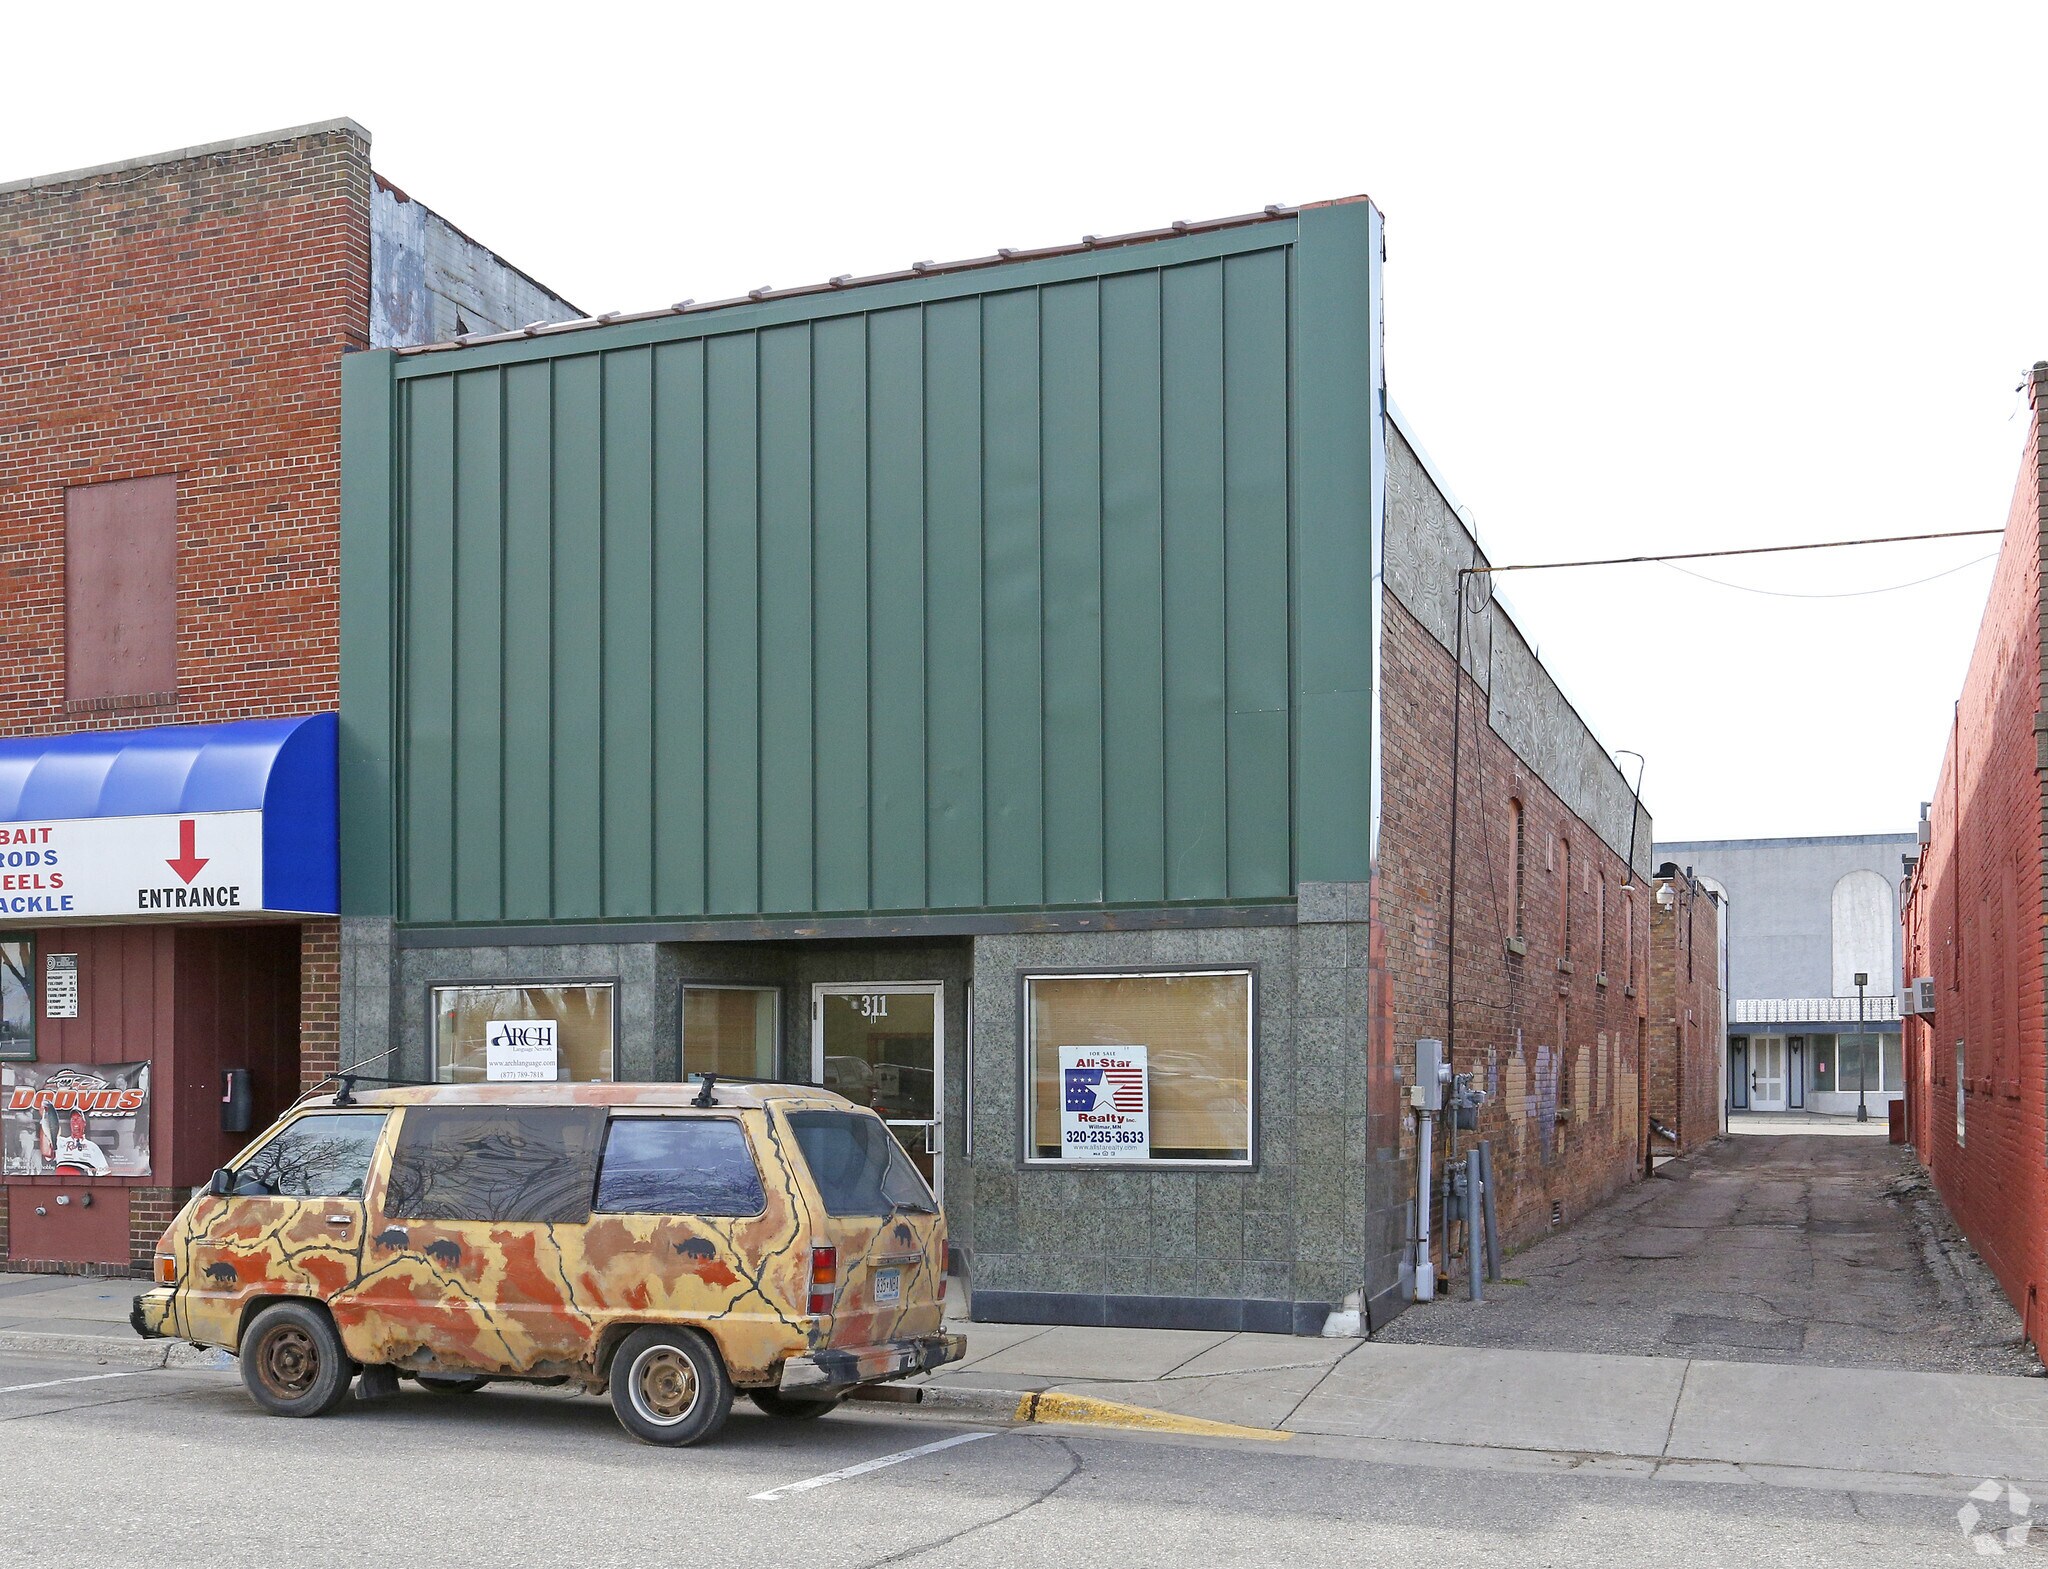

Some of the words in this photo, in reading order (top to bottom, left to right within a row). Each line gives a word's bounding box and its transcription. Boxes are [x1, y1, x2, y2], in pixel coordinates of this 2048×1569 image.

[0, 828, 52, 845] BAIT
[3, 872, 64, 890] EELS
[138, 886, 240, 909] ENTRANCE
[861, 995, 888, 1017] 311
[491, 1024, 552, 1046] ARCH
[1076, 1058, 1131, 1068] All-Star
[1078, 1113, 1125, 1124] Realty
[1066, 1131, 1144, 1143] 320-235-3633
